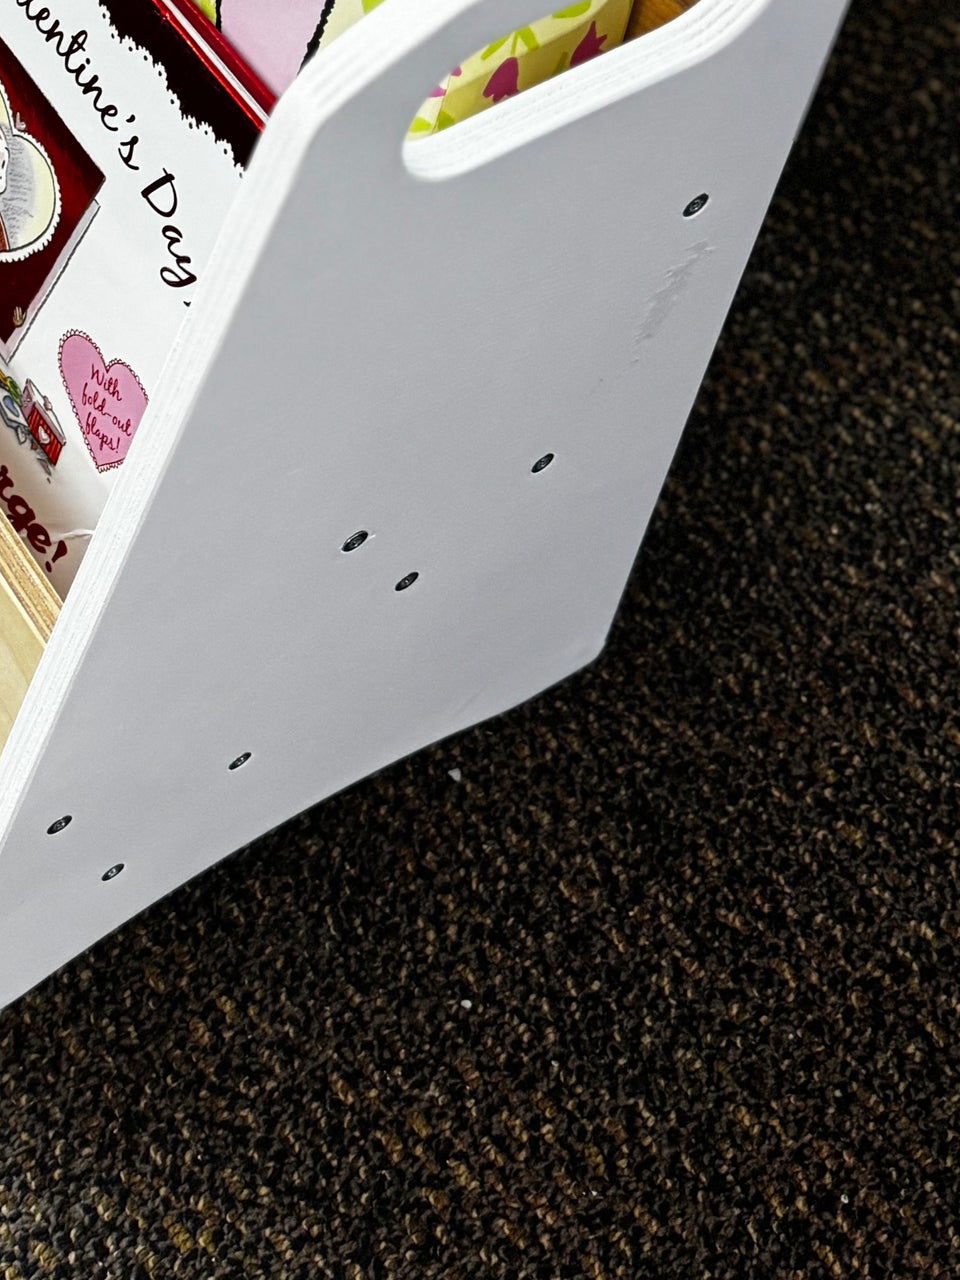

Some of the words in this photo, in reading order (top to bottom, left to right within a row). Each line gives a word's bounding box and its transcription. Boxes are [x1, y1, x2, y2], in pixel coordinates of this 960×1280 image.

[90, 363, 123, 401] With
[81, 382, 132, 437] fold-out
[85, 411, 121, 454] flaps!
